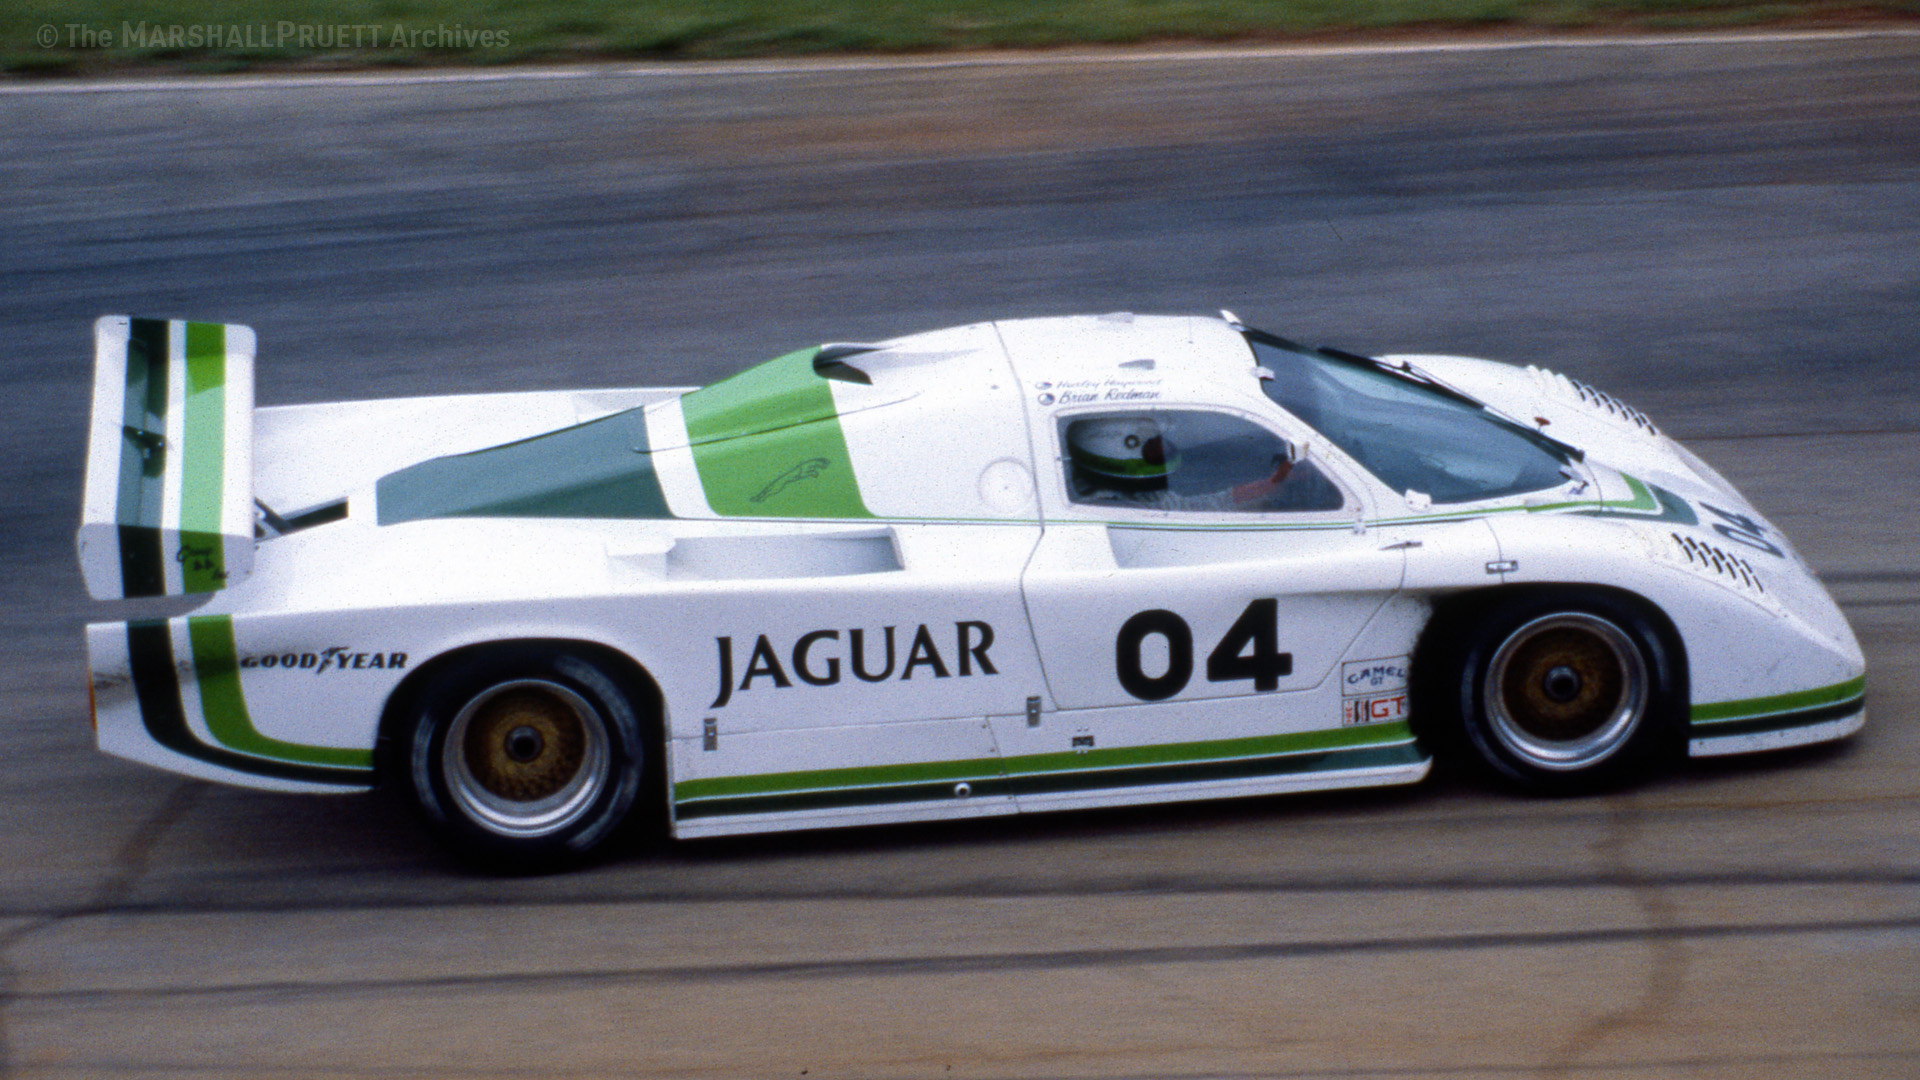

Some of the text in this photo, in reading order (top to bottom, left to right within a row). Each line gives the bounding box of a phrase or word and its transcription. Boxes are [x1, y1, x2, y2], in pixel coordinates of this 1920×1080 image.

[1058, 388, 1160, 404] Brian Redman
[1116, 598, 1292, 701] 04
[710, 620, 998, 708] JAGUAR
[1348, 666, 1405, 684] CAMEL
[1371, 695, 1406, 718] GT
